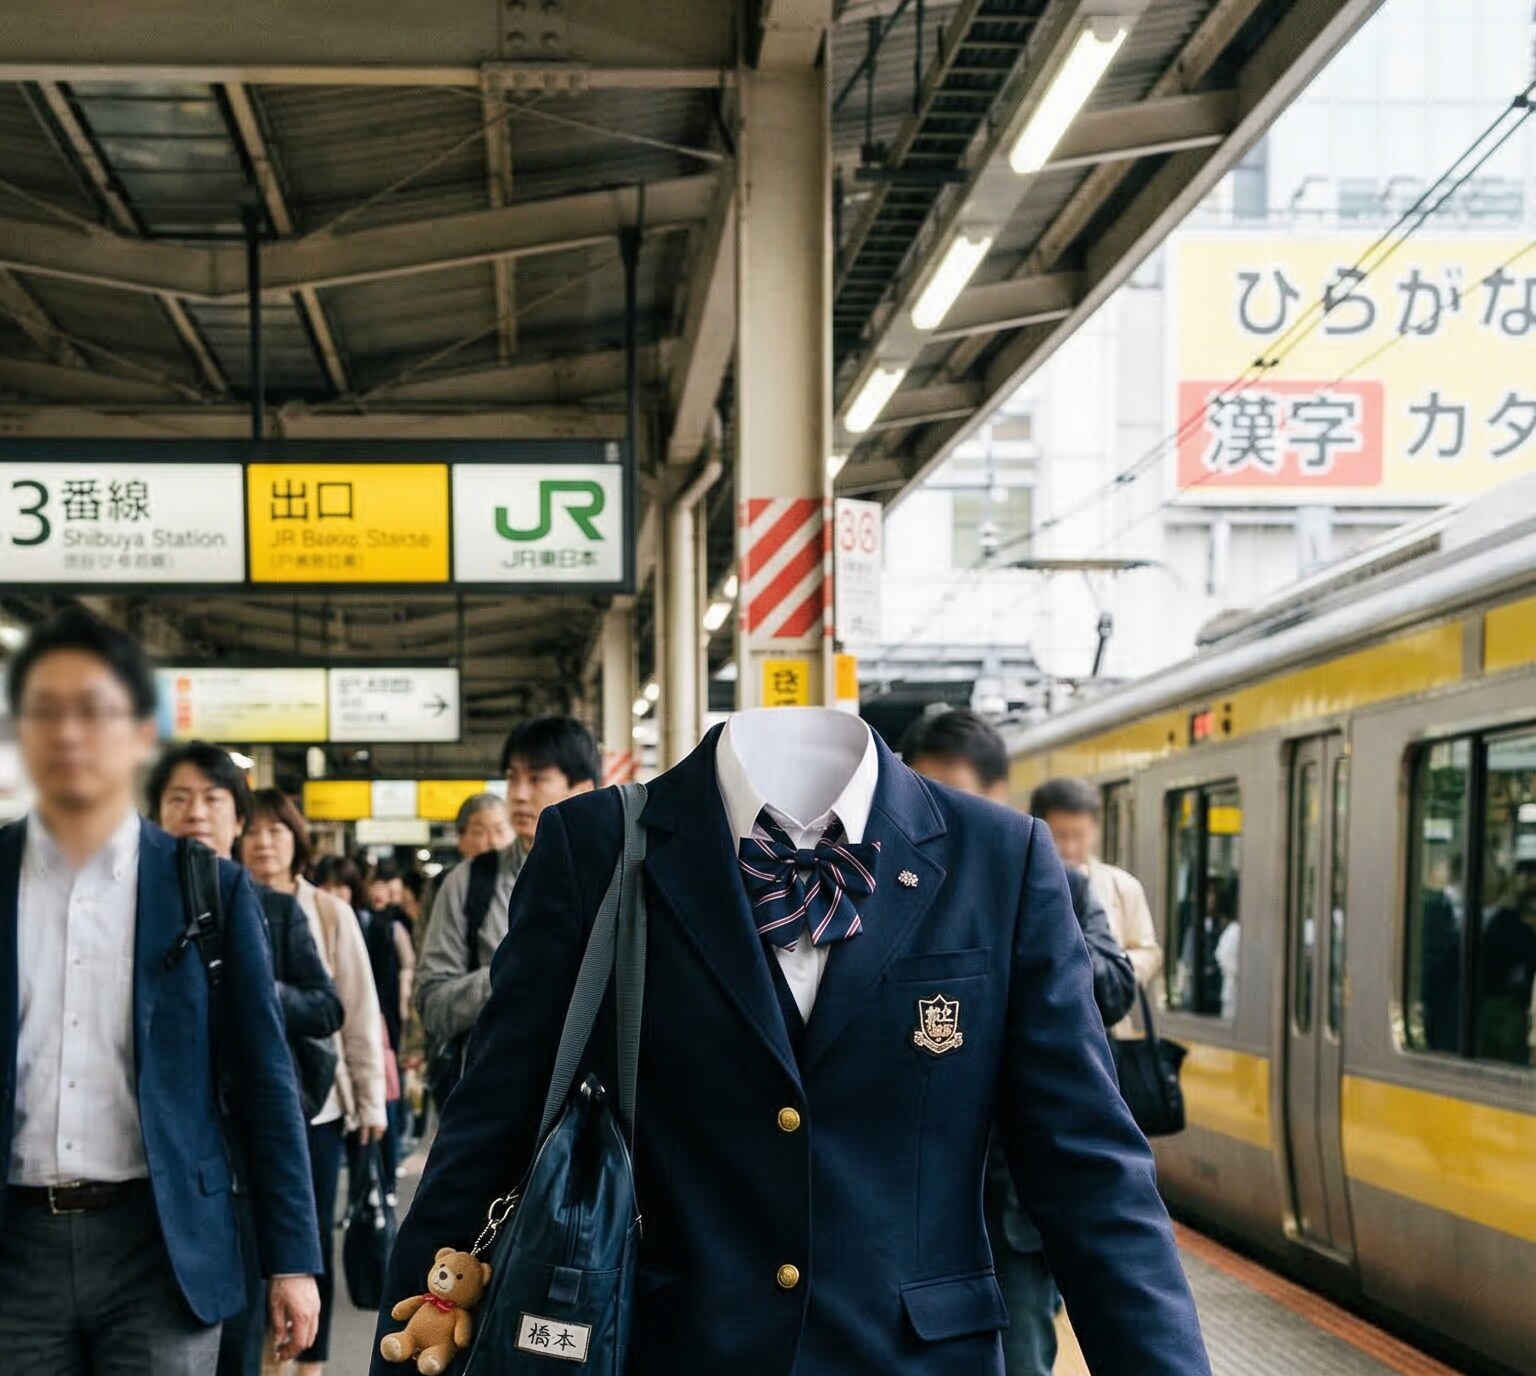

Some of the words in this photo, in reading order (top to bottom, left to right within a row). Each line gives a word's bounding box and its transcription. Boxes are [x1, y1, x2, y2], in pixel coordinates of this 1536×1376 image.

[1237, 267, 1536, 336] ひらがな
[1208, 395, 1355, 467] 漢字
[1407, 392, 1536, 458] カタ
[271, 479, 353, 522] 出口
[495, 480, 605, 542] JR
[63, 529, 145, 552] Shibuya
[152, 529, 226, 548] Station
